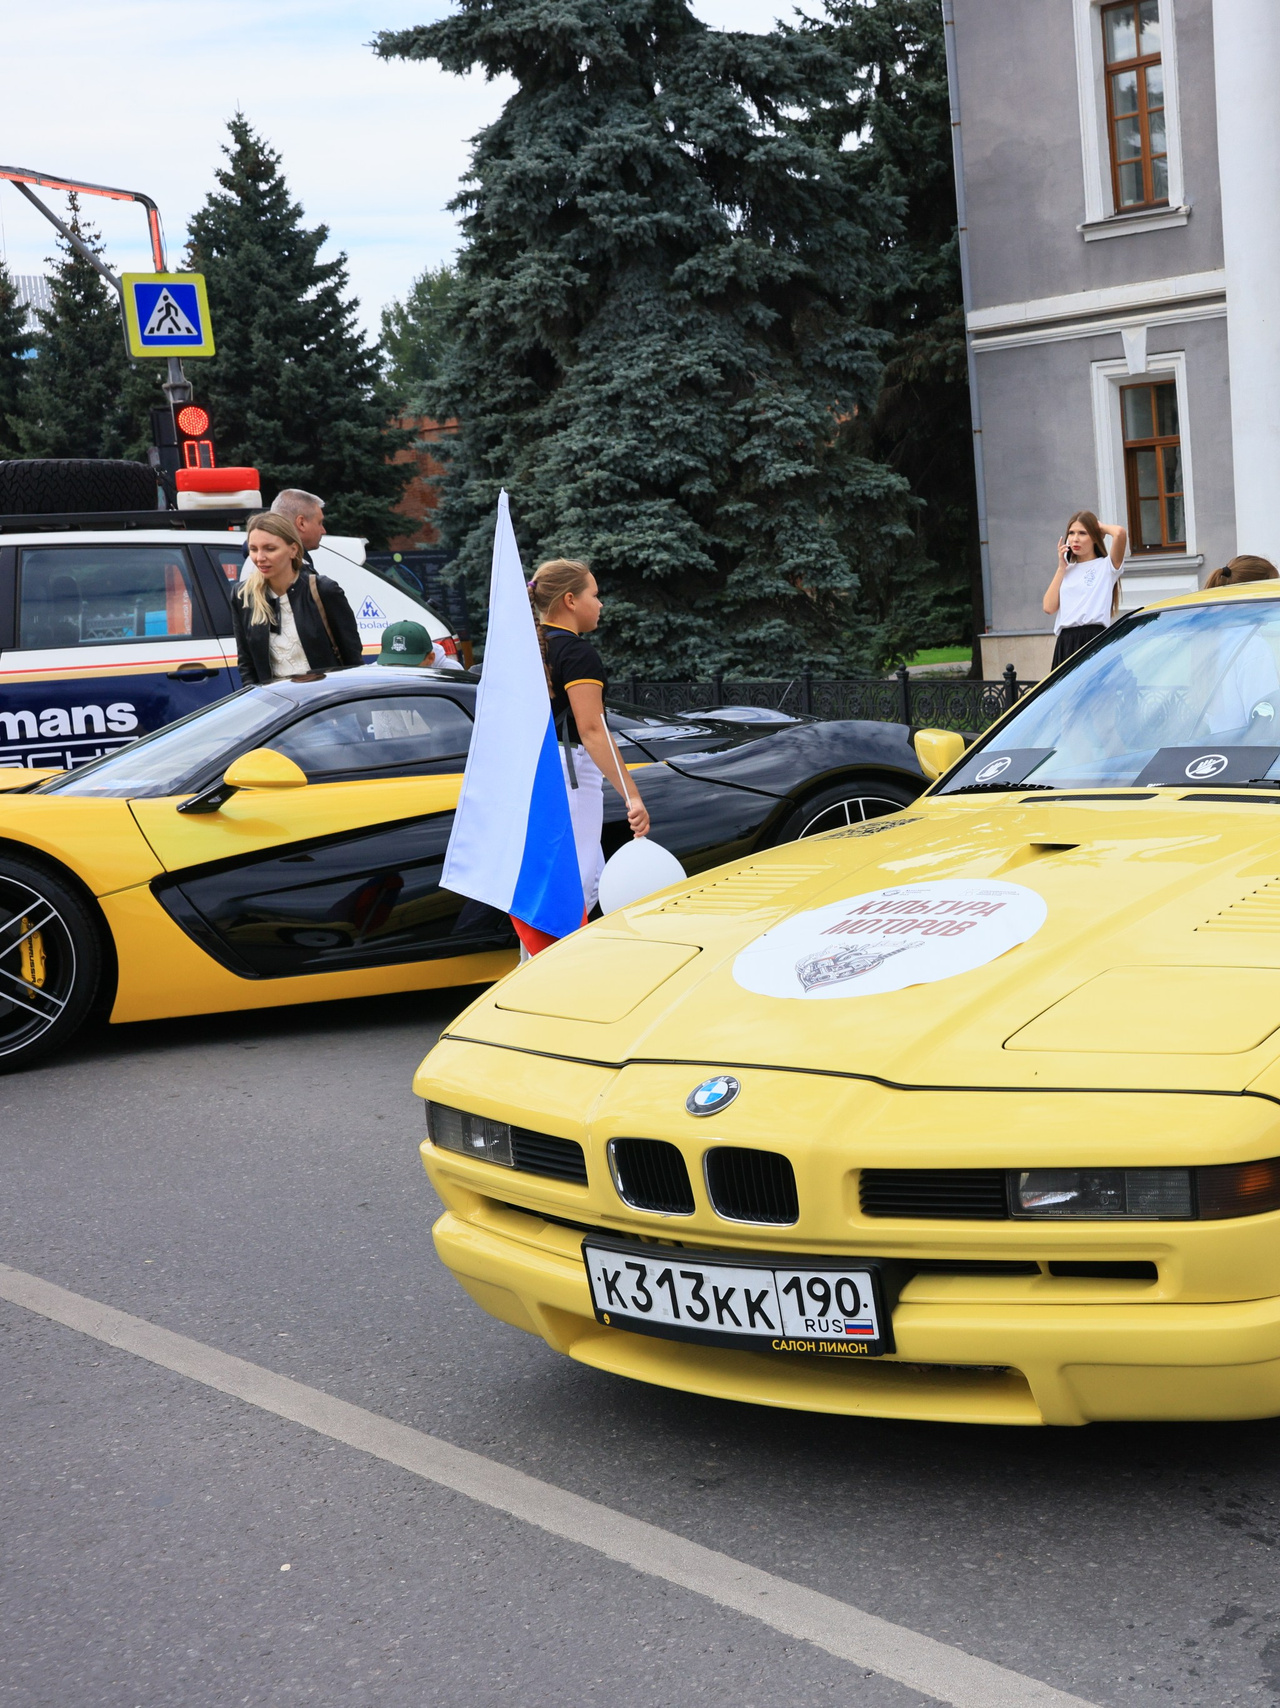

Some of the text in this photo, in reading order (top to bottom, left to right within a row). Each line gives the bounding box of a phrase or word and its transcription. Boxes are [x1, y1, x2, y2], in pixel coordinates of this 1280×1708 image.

[356, 620, 393, 630] bolad
[0, 702, 139, 740] mans
[845, 900, 1008, 917] КУЛЬТУРА
[818, 918, 978, 937] МОТОРОВ
[782, 1276, 861, 1318] 190
[804, 1318, 844, 1334] RUS
[772, 1339, 869, 1354] САЛОН ЛИМОН
